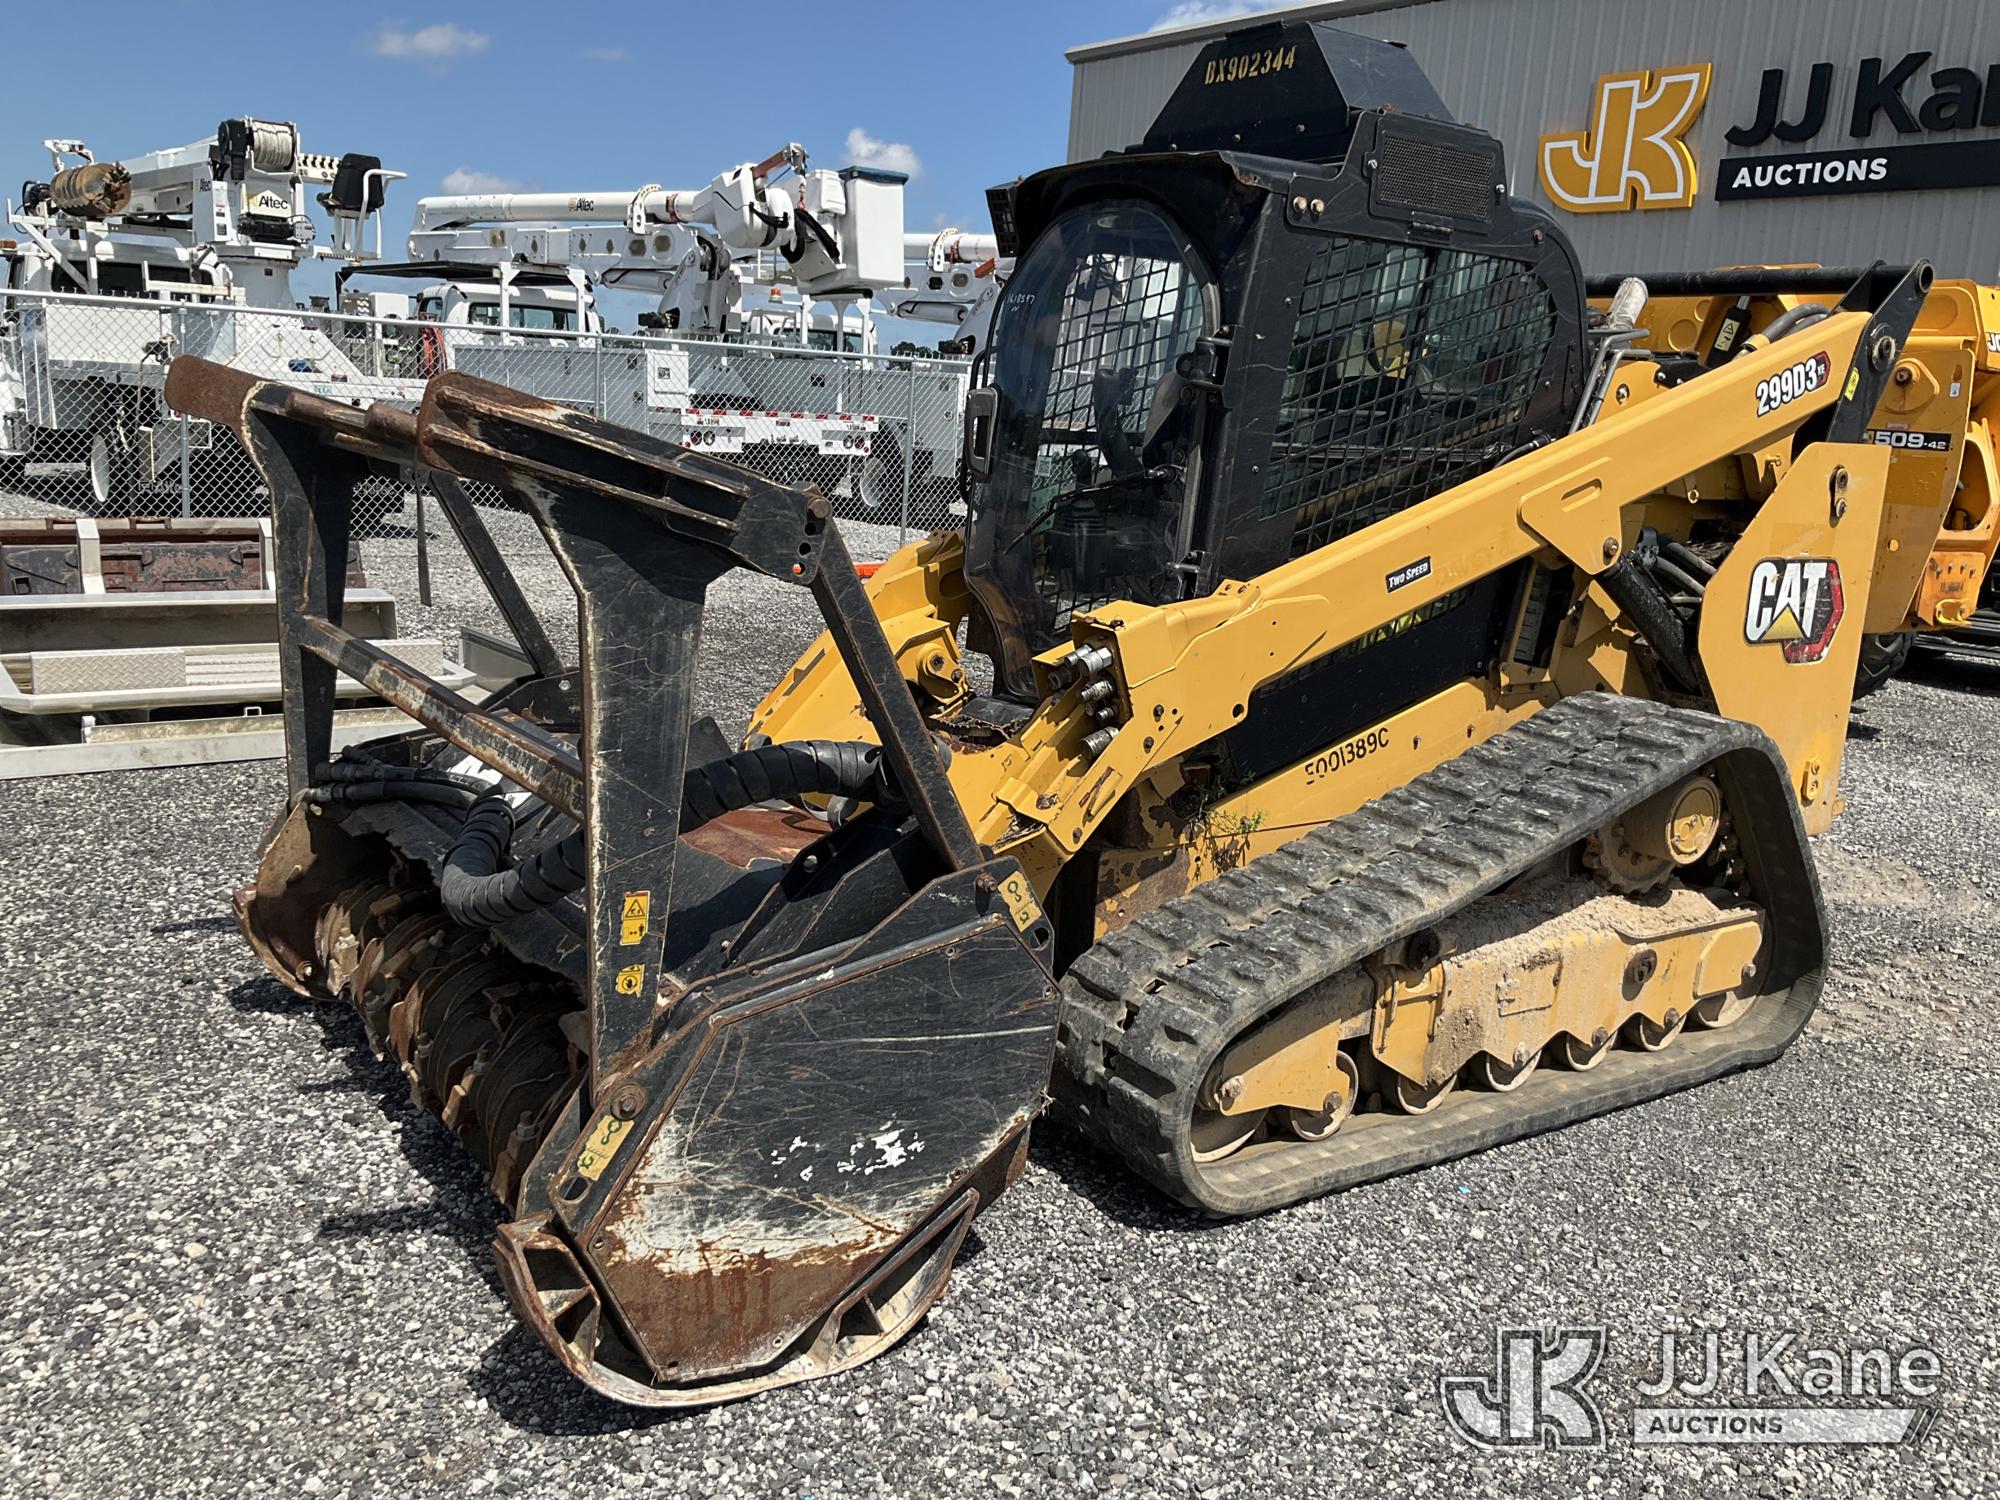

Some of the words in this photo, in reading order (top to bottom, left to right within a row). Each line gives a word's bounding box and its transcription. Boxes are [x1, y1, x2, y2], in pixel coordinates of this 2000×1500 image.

[1205, 45, 1297, 85] BX902344
[1724, 62, 1834, 147] JJ
[1732, 157, 1889, 189] AUCTIONS
[258, 195, 289, 210] Altec
[576, 198, 594, 211] Altec
[1756, 357, 1818, 416] 299D3
[1388, 573, 1405, 588] TWO
[1406, 562, 1428, 580] SPEED
[1746, 561, 1828, 641] CAT
